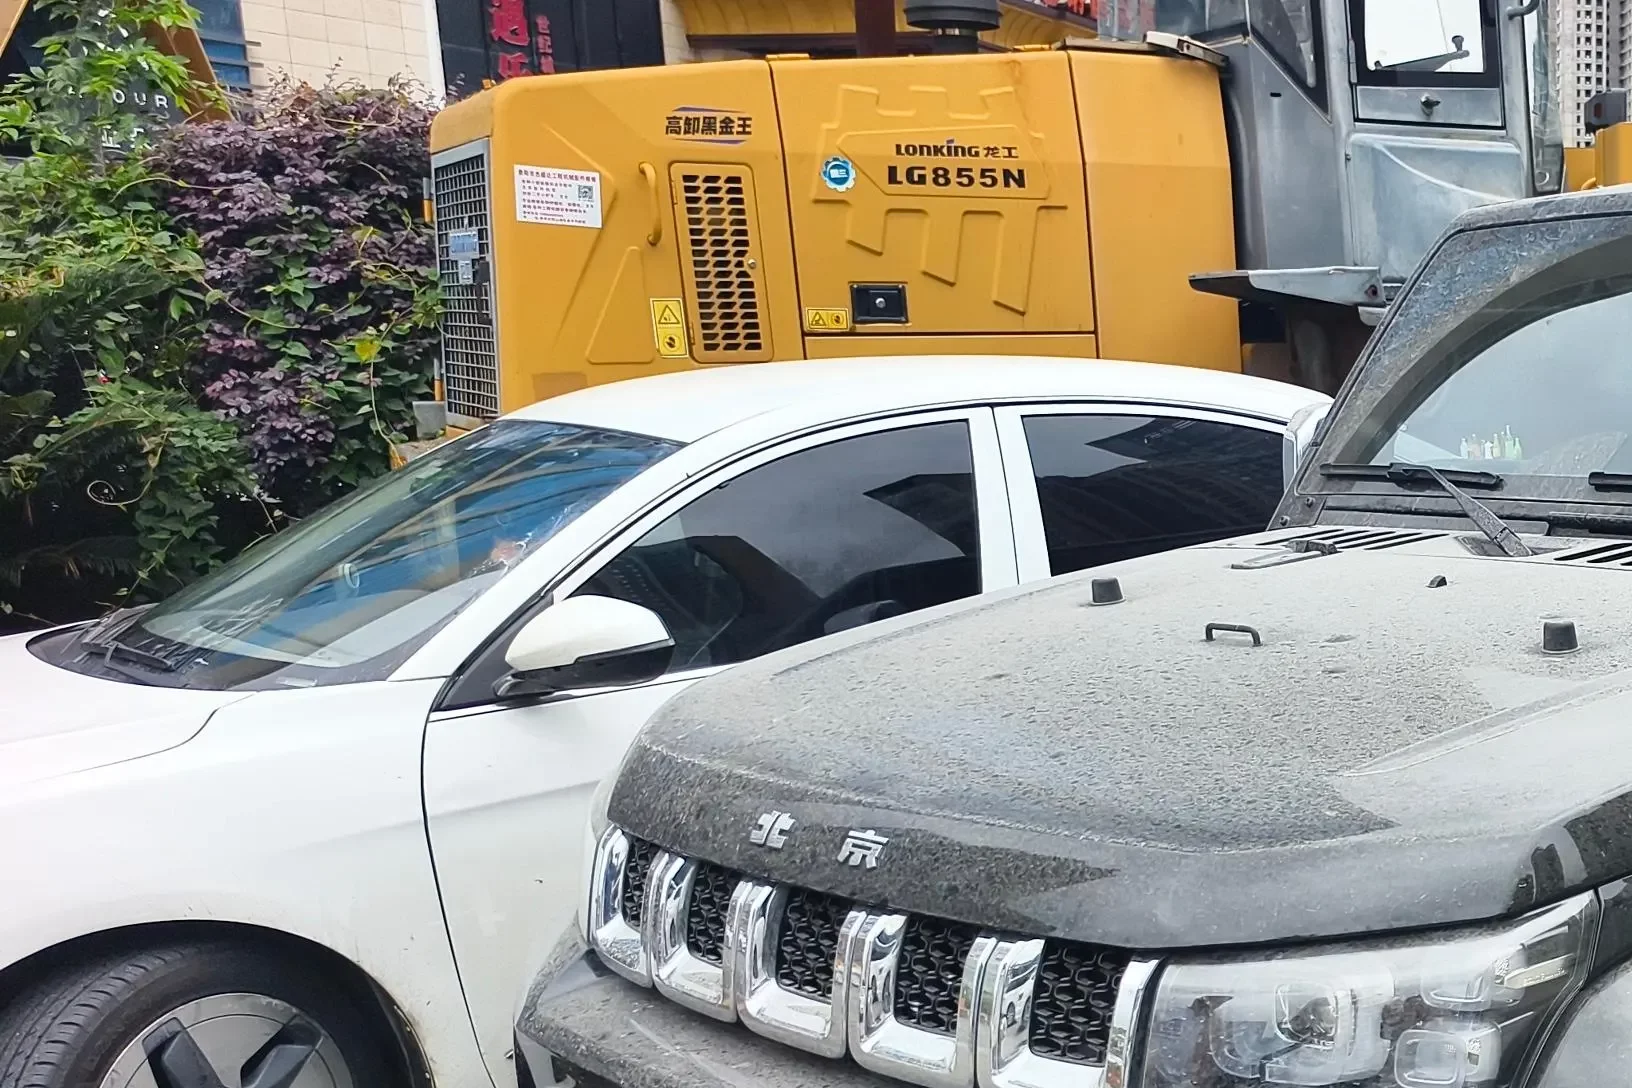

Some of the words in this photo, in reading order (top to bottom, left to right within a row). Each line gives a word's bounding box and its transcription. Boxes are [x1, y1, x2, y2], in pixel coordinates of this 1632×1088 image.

[665, 115, 752, 136] 高卸黑金王
[984, 146, 1018, 159] 龙工
[887, 165, 1026, 188] LG855N
[749, 810, 889, 869] 北京
